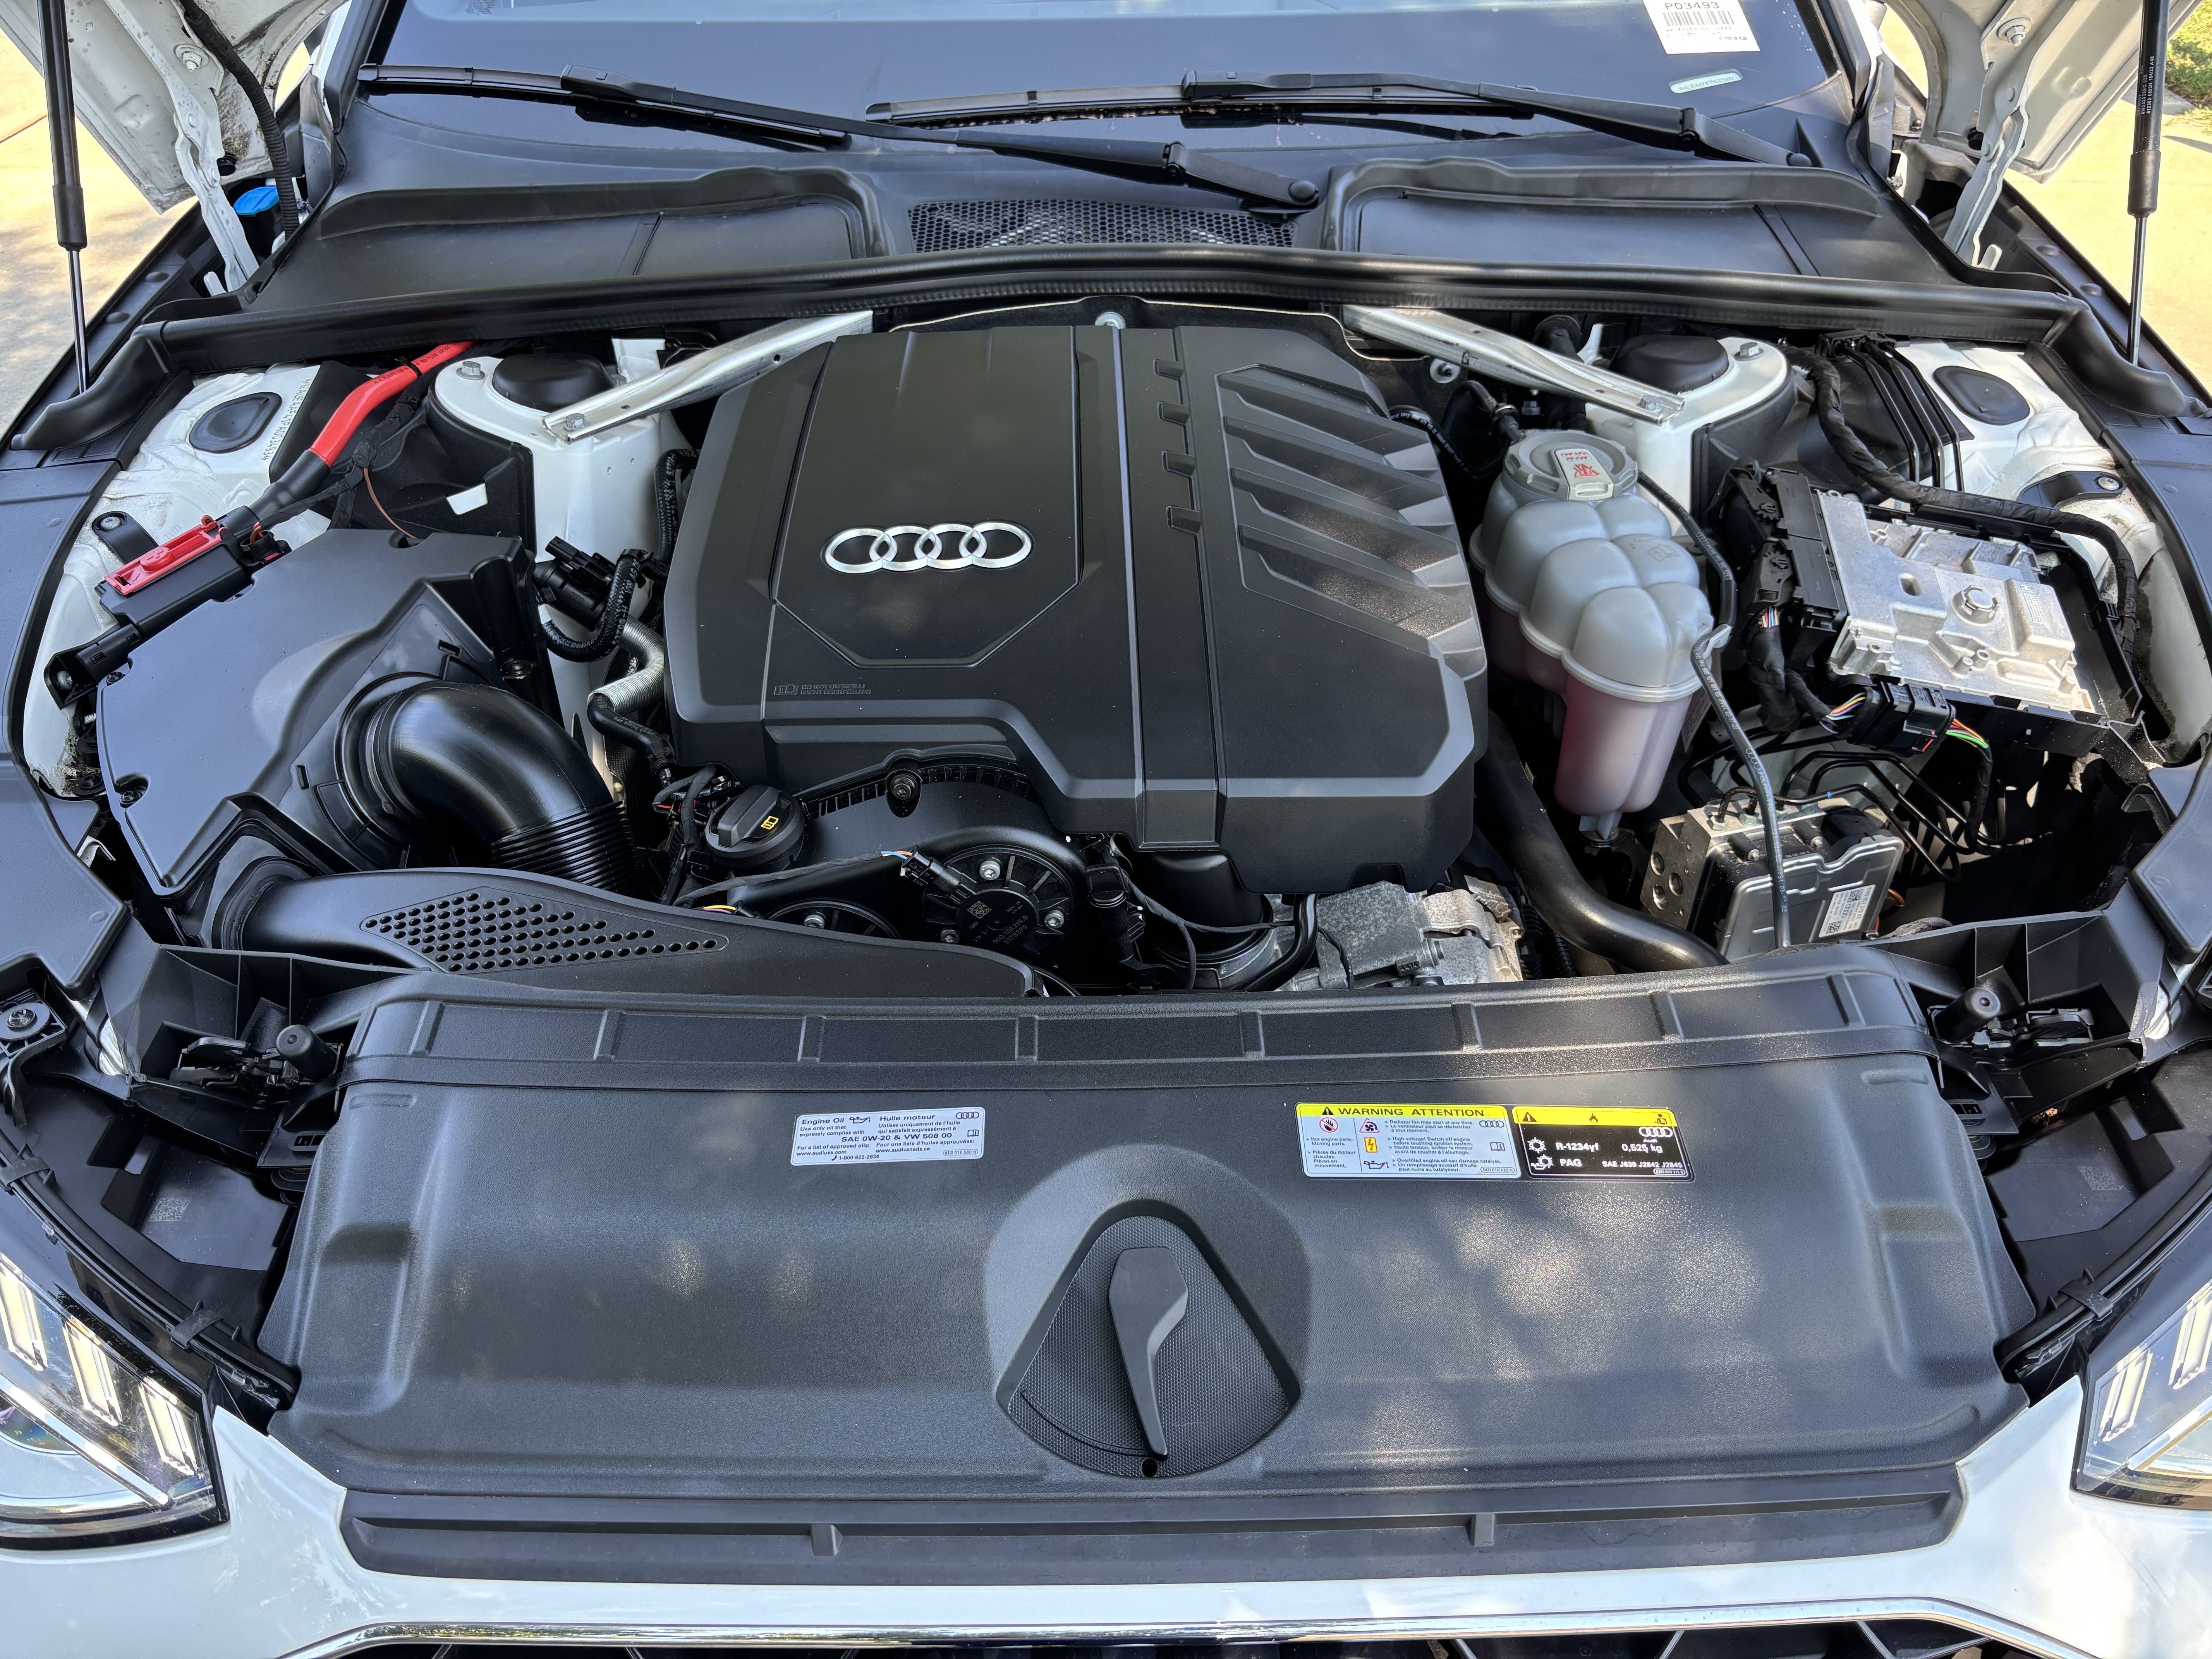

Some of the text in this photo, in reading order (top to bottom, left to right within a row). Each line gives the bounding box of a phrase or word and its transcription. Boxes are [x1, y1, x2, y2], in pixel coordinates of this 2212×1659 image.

[1665, 2, 1720, 10] P03493
[1556, 1142, 1663, 1154] R-1234yf 0,525 kg
[1560, 1159, 1582, 1167] PAG
